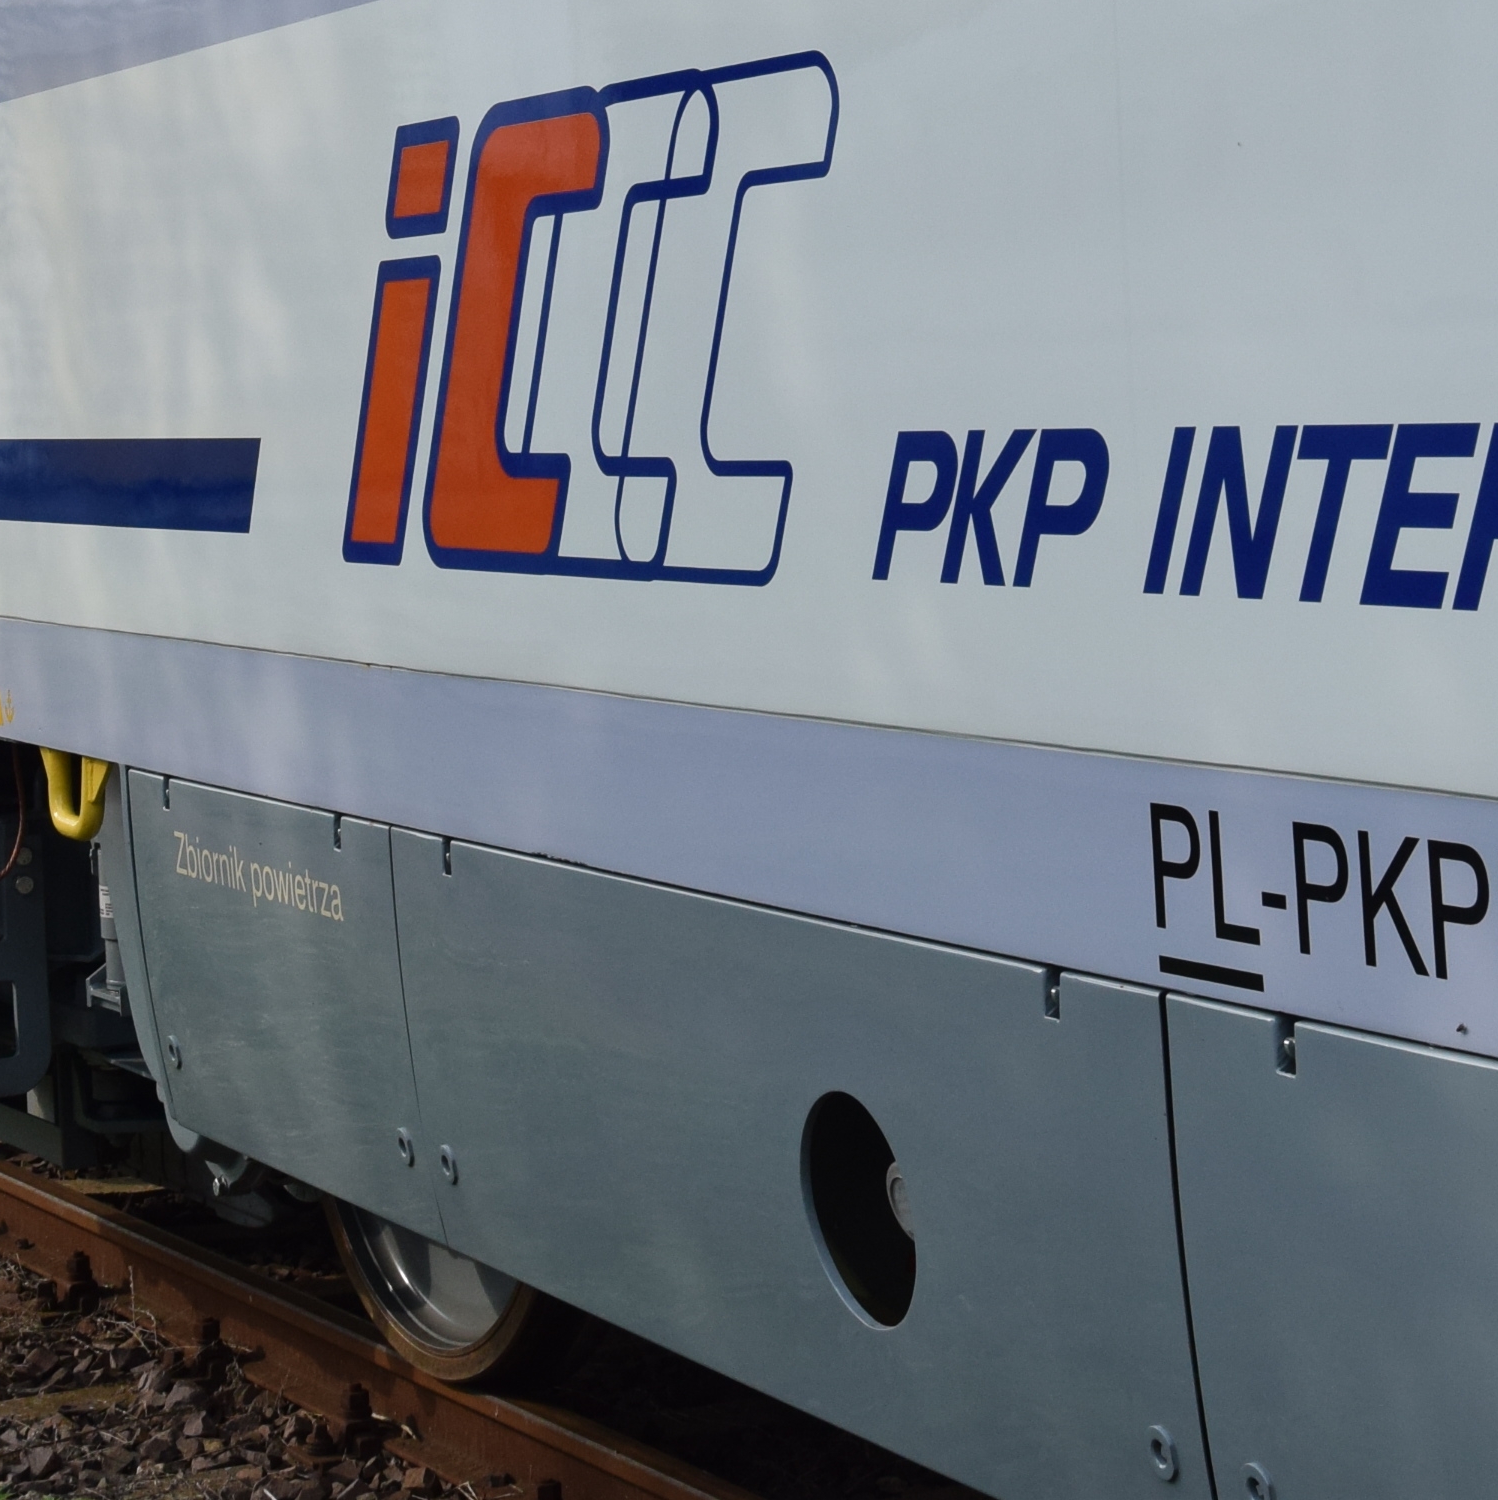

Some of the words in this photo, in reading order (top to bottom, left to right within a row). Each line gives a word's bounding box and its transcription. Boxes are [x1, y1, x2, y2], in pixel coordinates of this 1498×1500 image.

[872, 428, 1109, 587] PKP
[173, 830, 247, 892] Zbiornik
[250, 861, 344, 922] powietrza
